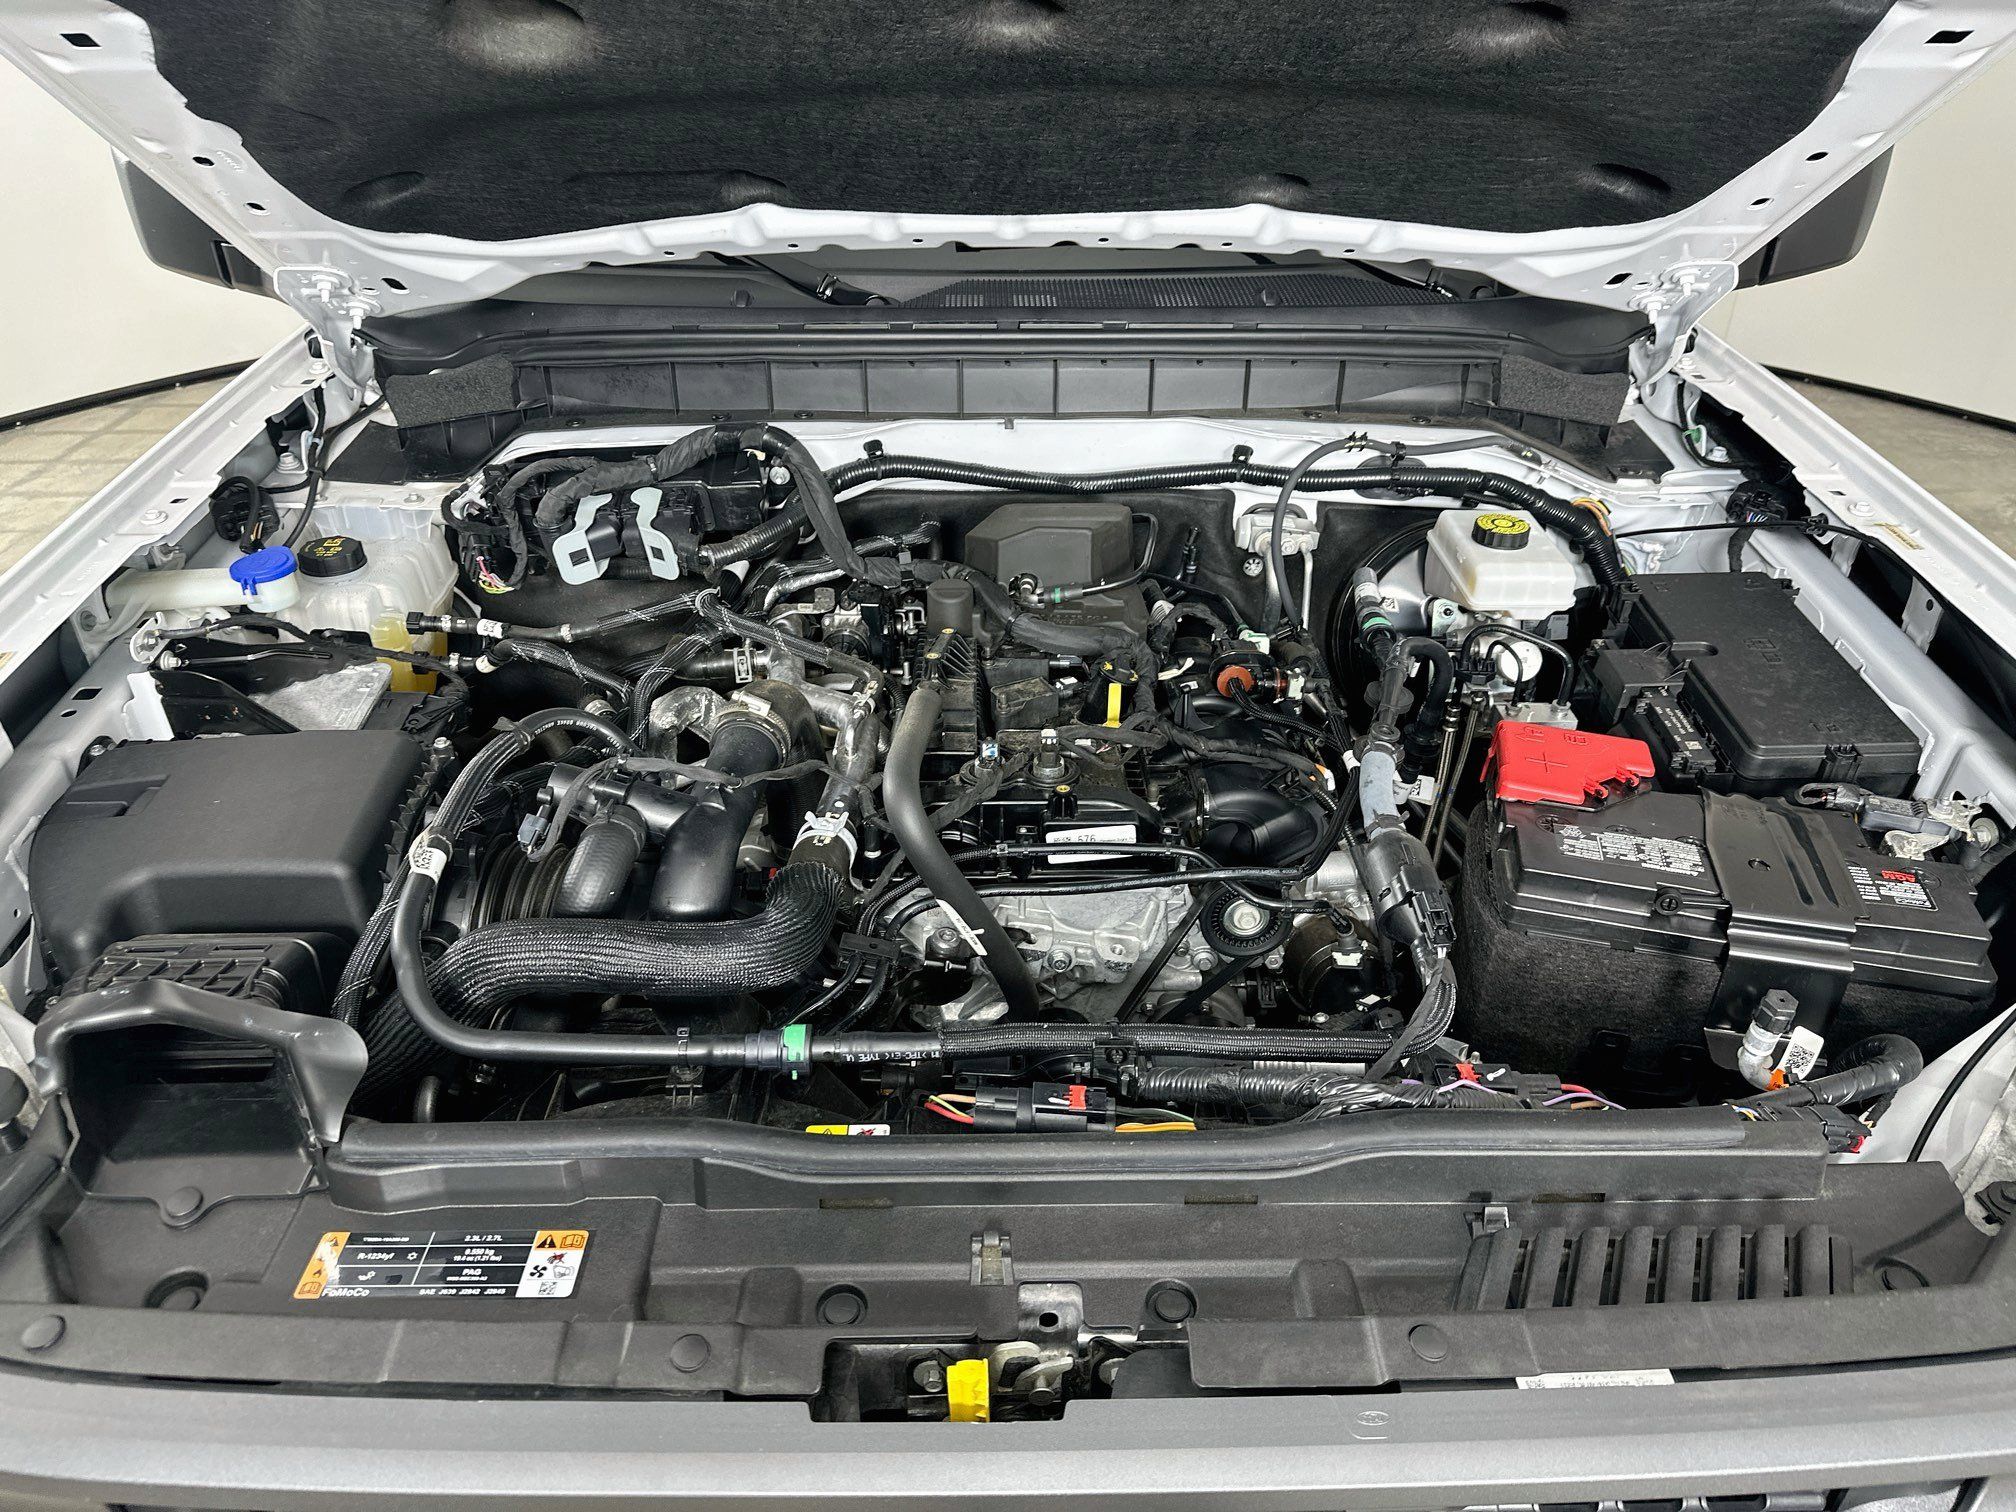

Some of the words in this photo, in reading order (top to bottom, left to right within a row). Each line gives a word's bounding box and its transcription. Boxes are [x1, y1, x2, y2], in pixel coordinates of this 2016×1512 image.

[858, 1053, 880, 1062] TYPE
[357, 1252, 395, 1261] R-1234yf
[322, 1287, 370, 1297] FoMoCo
